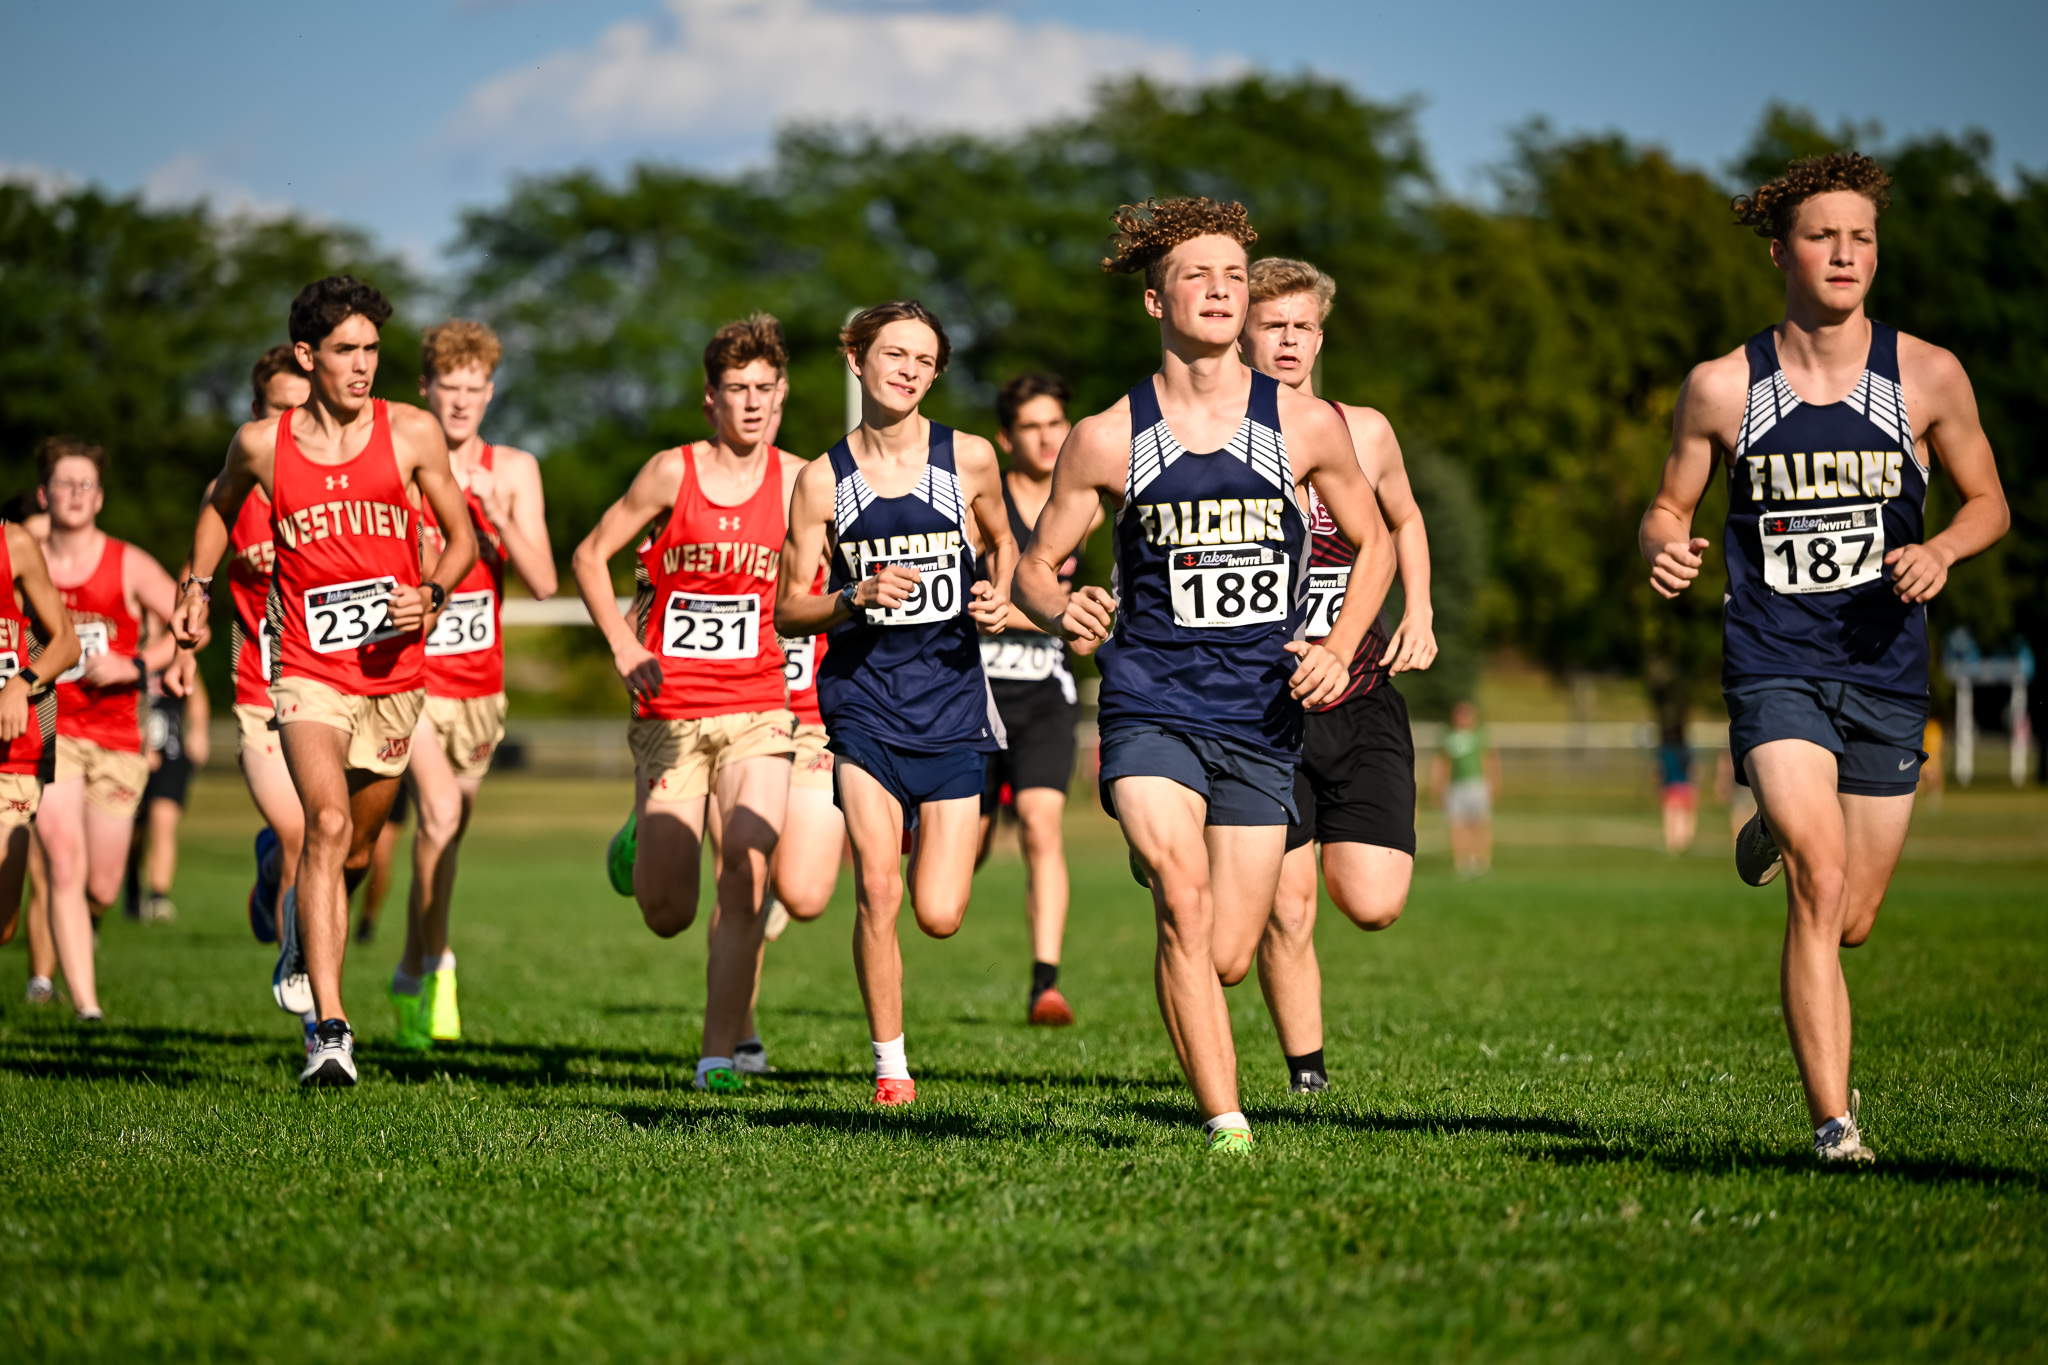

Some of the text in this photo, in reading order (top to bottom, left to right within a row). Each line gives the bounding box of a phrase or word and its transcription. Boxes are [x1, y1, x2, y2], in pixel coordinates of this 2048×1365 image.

[1746, 451, 1904, 501] FALCONS
[277, 500, 409, 549] WESTVIEW
[1136, 498, 1286, 546] FALCONS
[1786, 516, 1852, 533] Laker INVITE
[1196, 551, 1261, 567] Laker INVITE
[1773, 532, 1876, 586] 187
[885, 574, 954, 617] 90
[1181, 570, 1279, 618] 188
[314, 599, 394, 645] 232
[672, 616, 746, 651] 231
